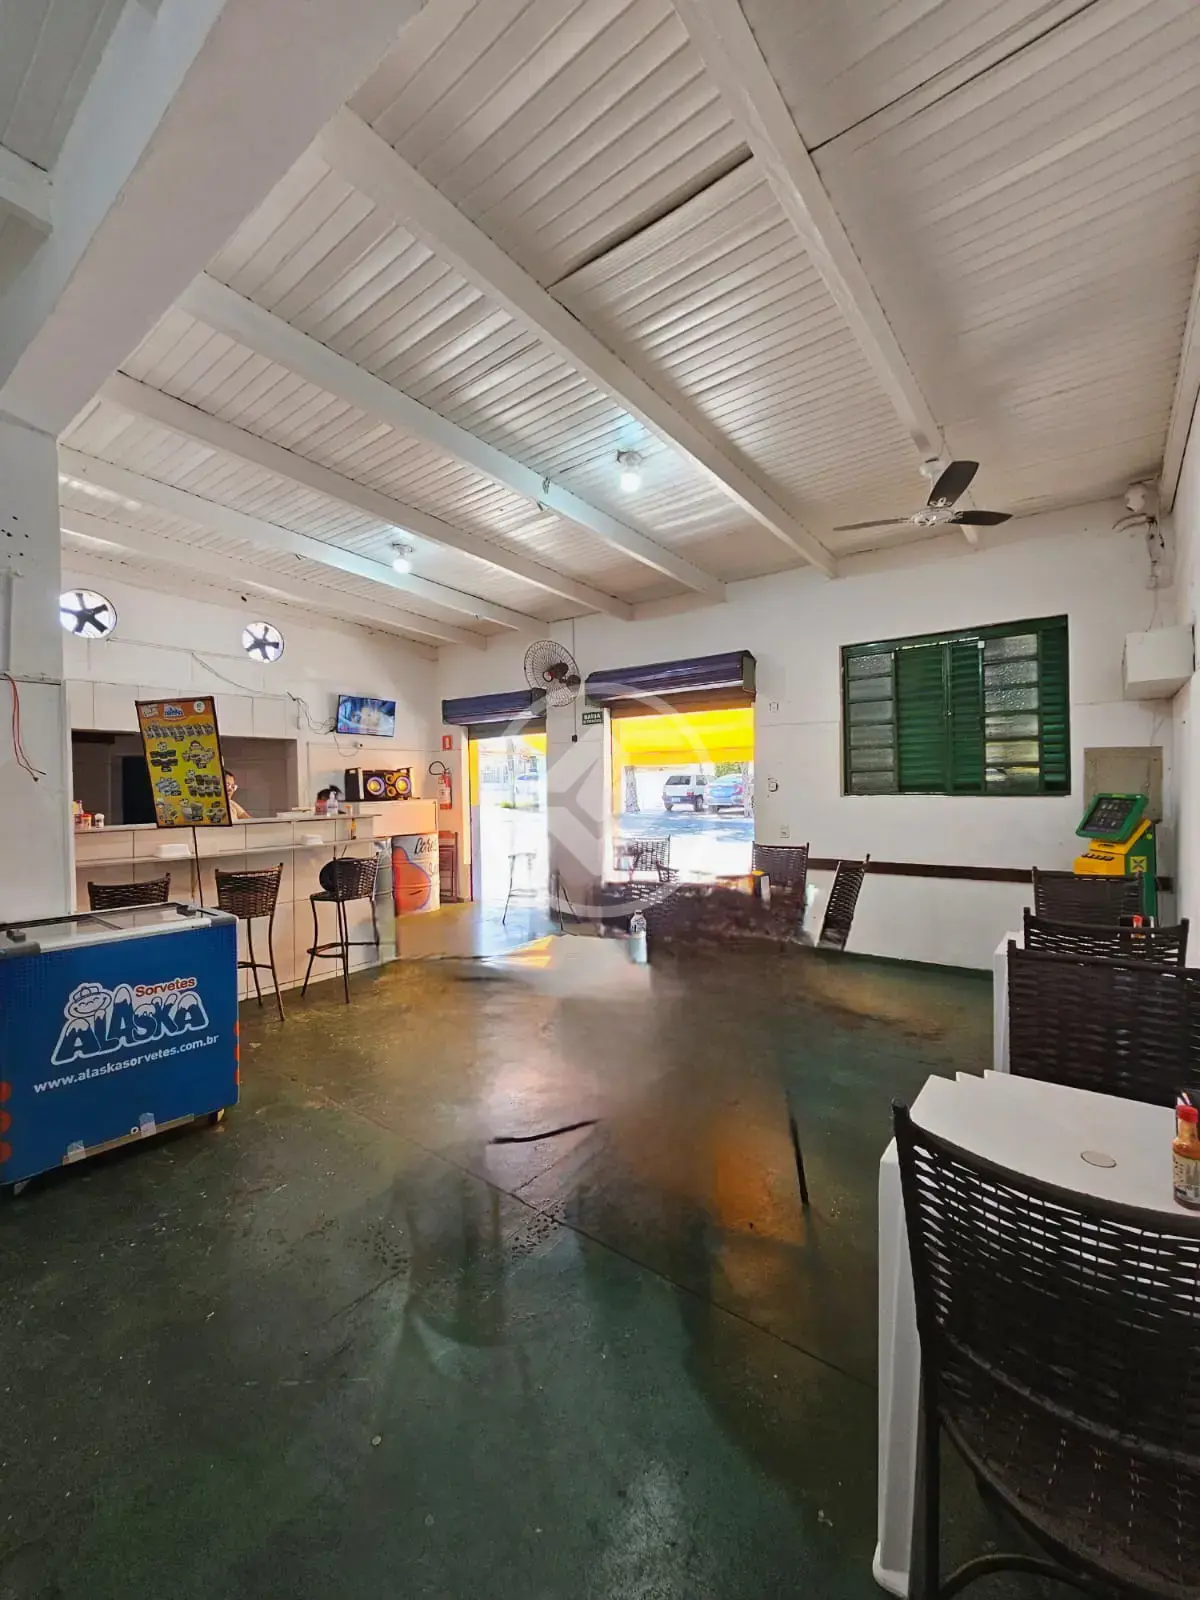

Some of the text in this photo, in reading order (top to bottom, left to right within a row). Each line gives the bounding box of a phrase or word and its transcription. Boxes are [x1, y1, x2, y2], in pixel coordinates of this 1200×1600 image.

[135, 977, 196, 998] Sorvetes
[51, 984, 210, 1066] ALASKA
[33, 1033, 220, 1094] www.alaskasorvetes.com.br
